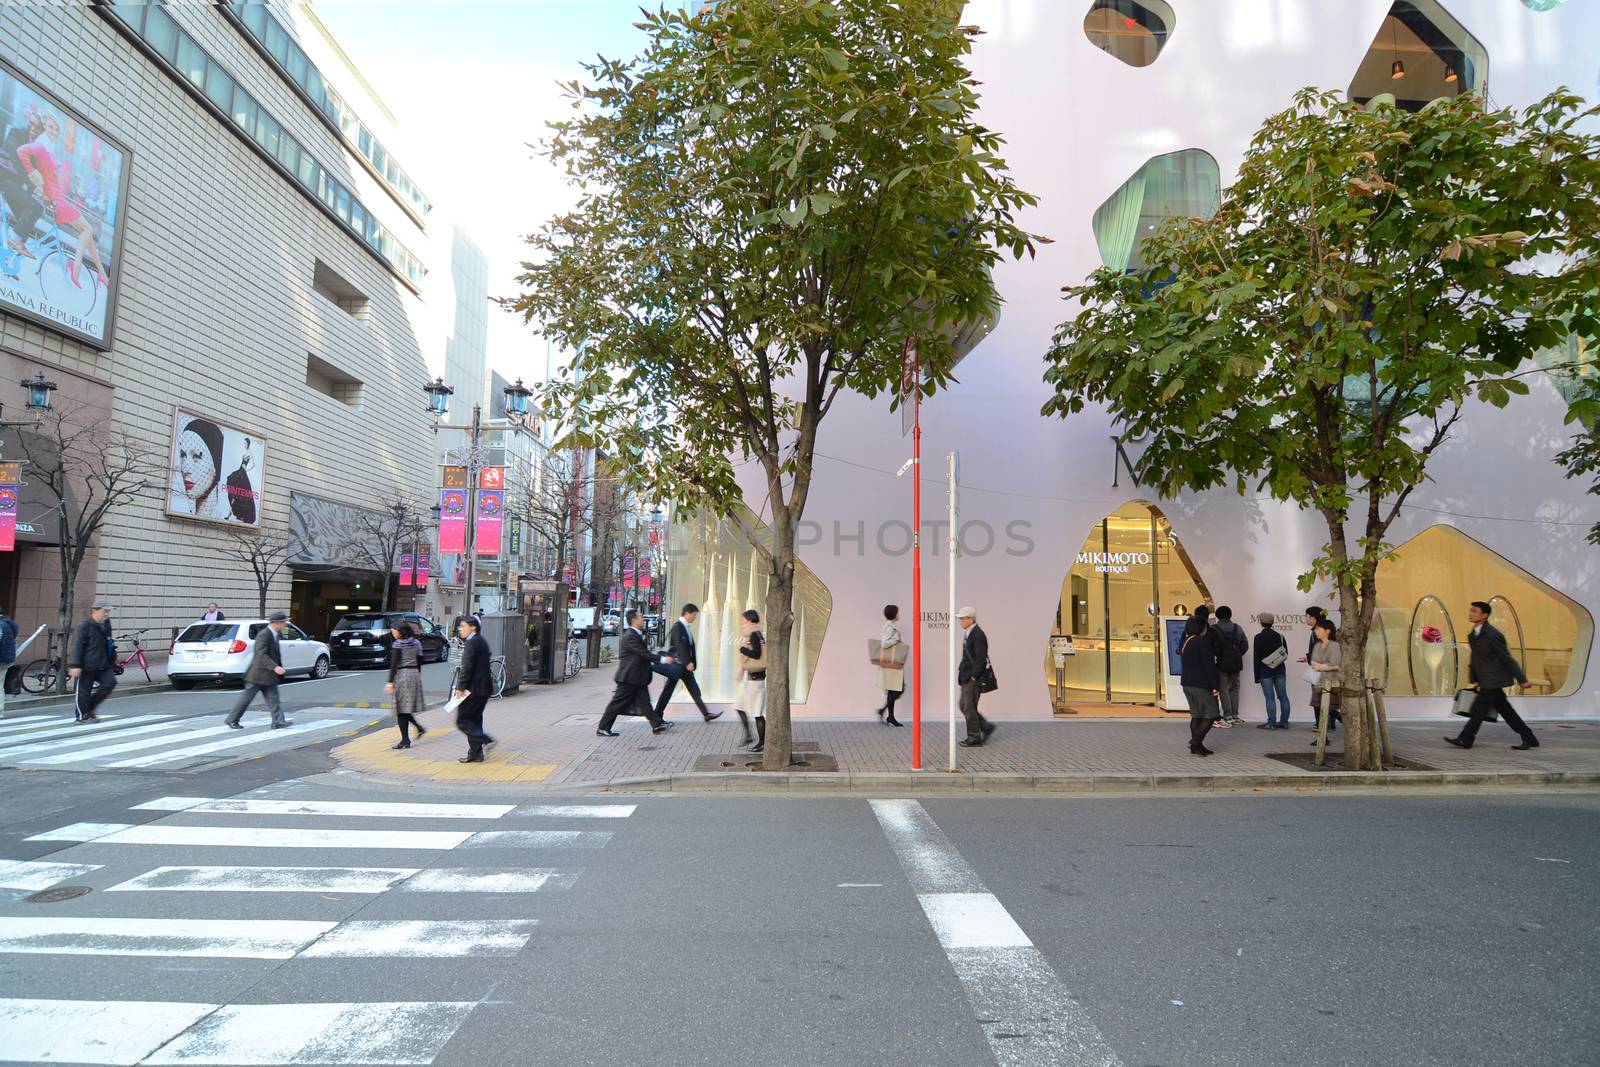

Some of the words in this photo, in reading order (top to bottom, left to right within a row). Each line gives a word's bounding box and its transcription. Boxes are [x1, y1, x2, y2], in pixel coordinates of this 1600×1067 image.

[40, 302, 98, 335] REPUBLIC
[221, 483, 260, 500] PRINTEMPS
[1075, 552, 1149, 564] MIKIMOTO
[1095, 565, 1130, 573] BOUTIQUE
